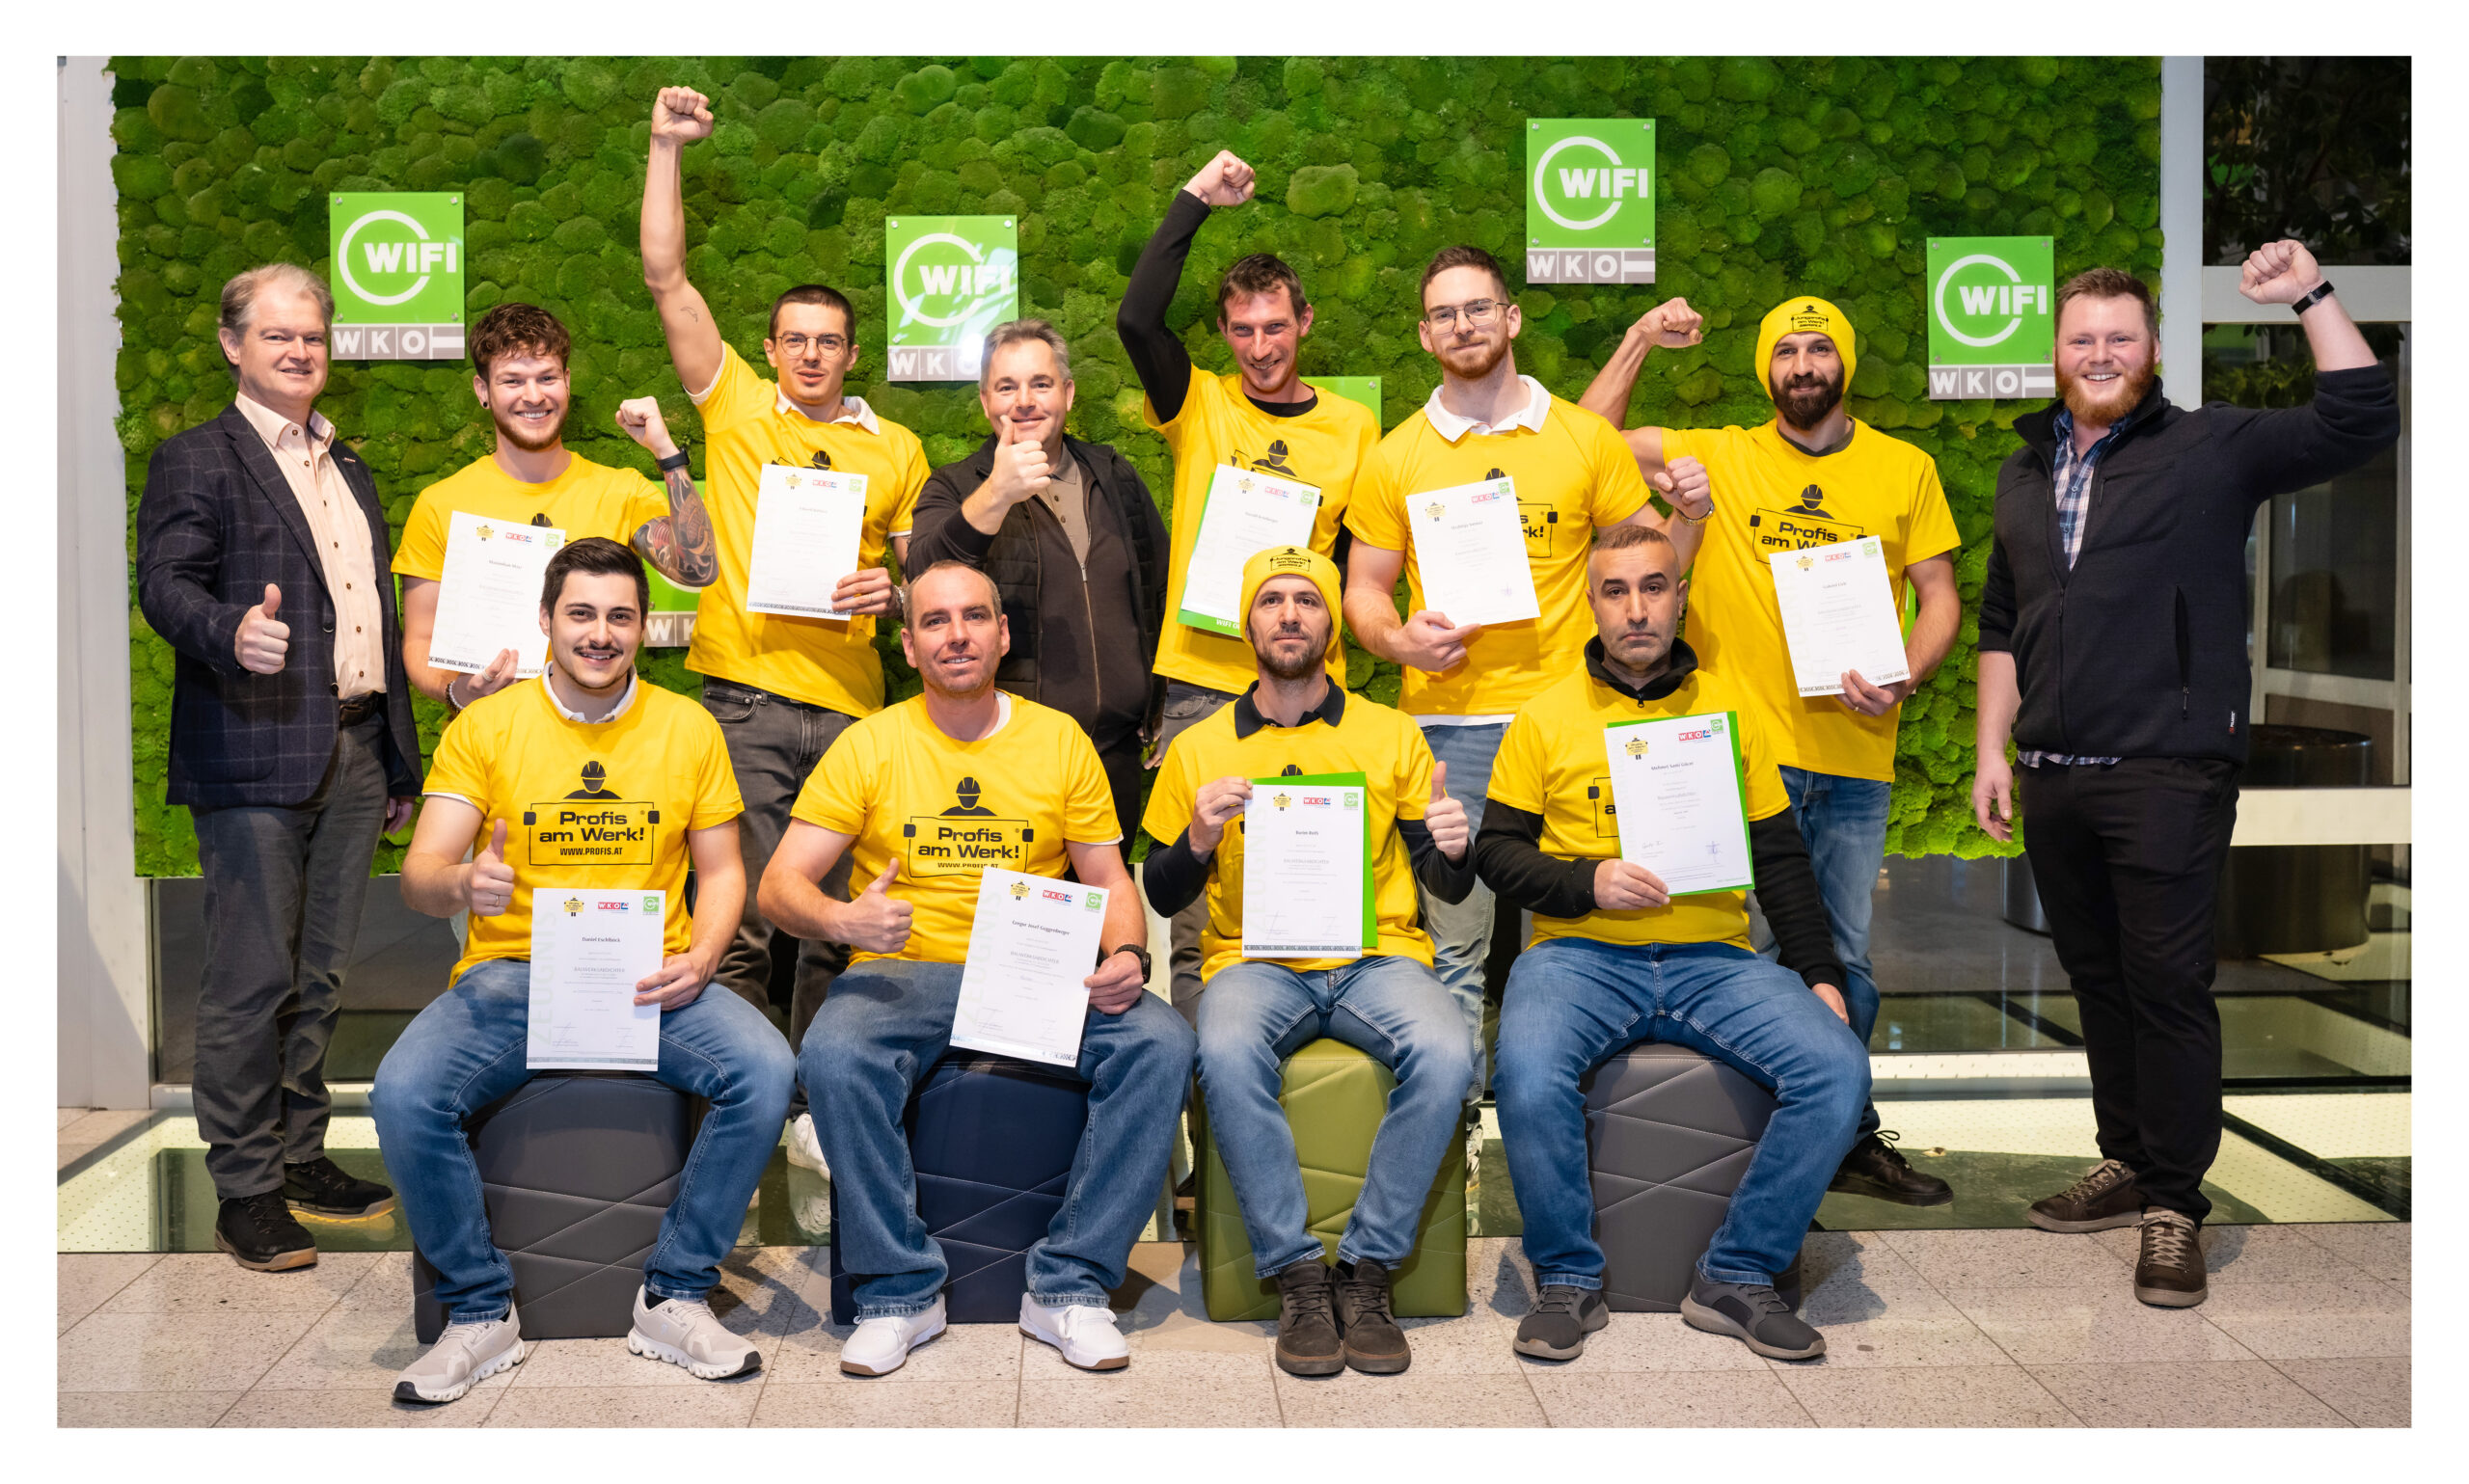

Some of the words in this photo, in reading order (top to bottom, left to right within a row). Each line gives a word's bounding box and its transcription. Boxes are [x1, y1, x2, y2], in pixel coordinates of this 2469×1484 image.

[1559, 168, 1648, 199] WIFI
[364, 242, 457, 273] WIFI
[1528, 254, 1618, 279] WKO
[919, 264, 1011, 295] WIFI
[1959, 284, 2048, 316] WIFI
[333, 330, 426, 355] WKO
[1931, 370, 2019, 394] WKO
[1778, 521, 1838, 543] Profis
[1761, 535, 1790, 549] am
[645, 618, 696, 641] WK
[1678, 730, 1703, 742] WKO
[559, 811, 628, 825] Profis
[539, 830, 574, 843] am
[581, 827, 645, 842] Werk!
[937, 826, 1003, 843] Profis
[559, 847, 623, 856] WWW.PROFIS.AT
[918, 845, 951, 857] am
[957, 844, 1019, 859] Werk!
[1043, 889, 1066, 902] WKO
[598, 902, 620, 910] WKO
